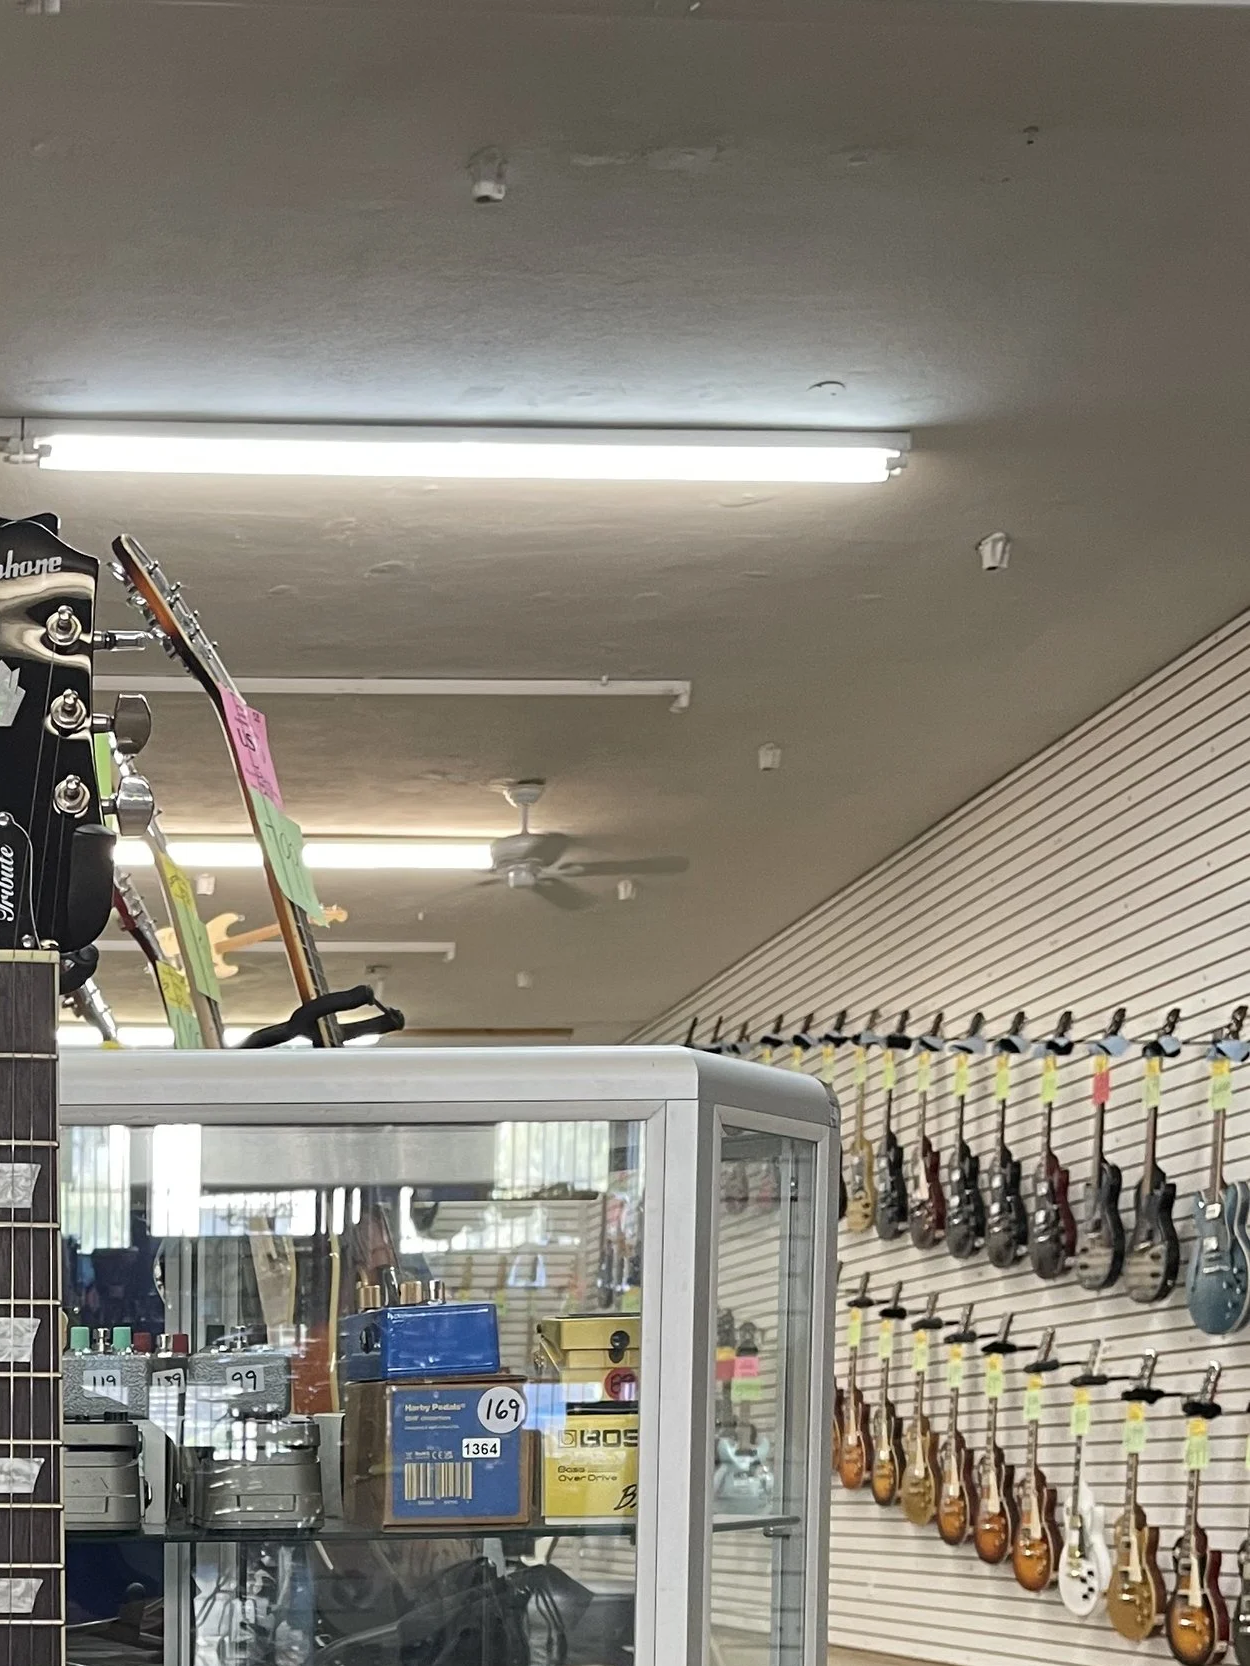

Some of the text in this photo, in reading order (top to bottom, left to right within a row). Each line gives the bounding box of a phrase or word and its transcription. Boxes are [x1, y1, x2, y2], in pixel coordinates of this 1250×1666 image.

[230, 1370, 257, 1391] 99
[486, 1398, 520, 1422] 169
[464, 1443, 498, 1455] 1364
